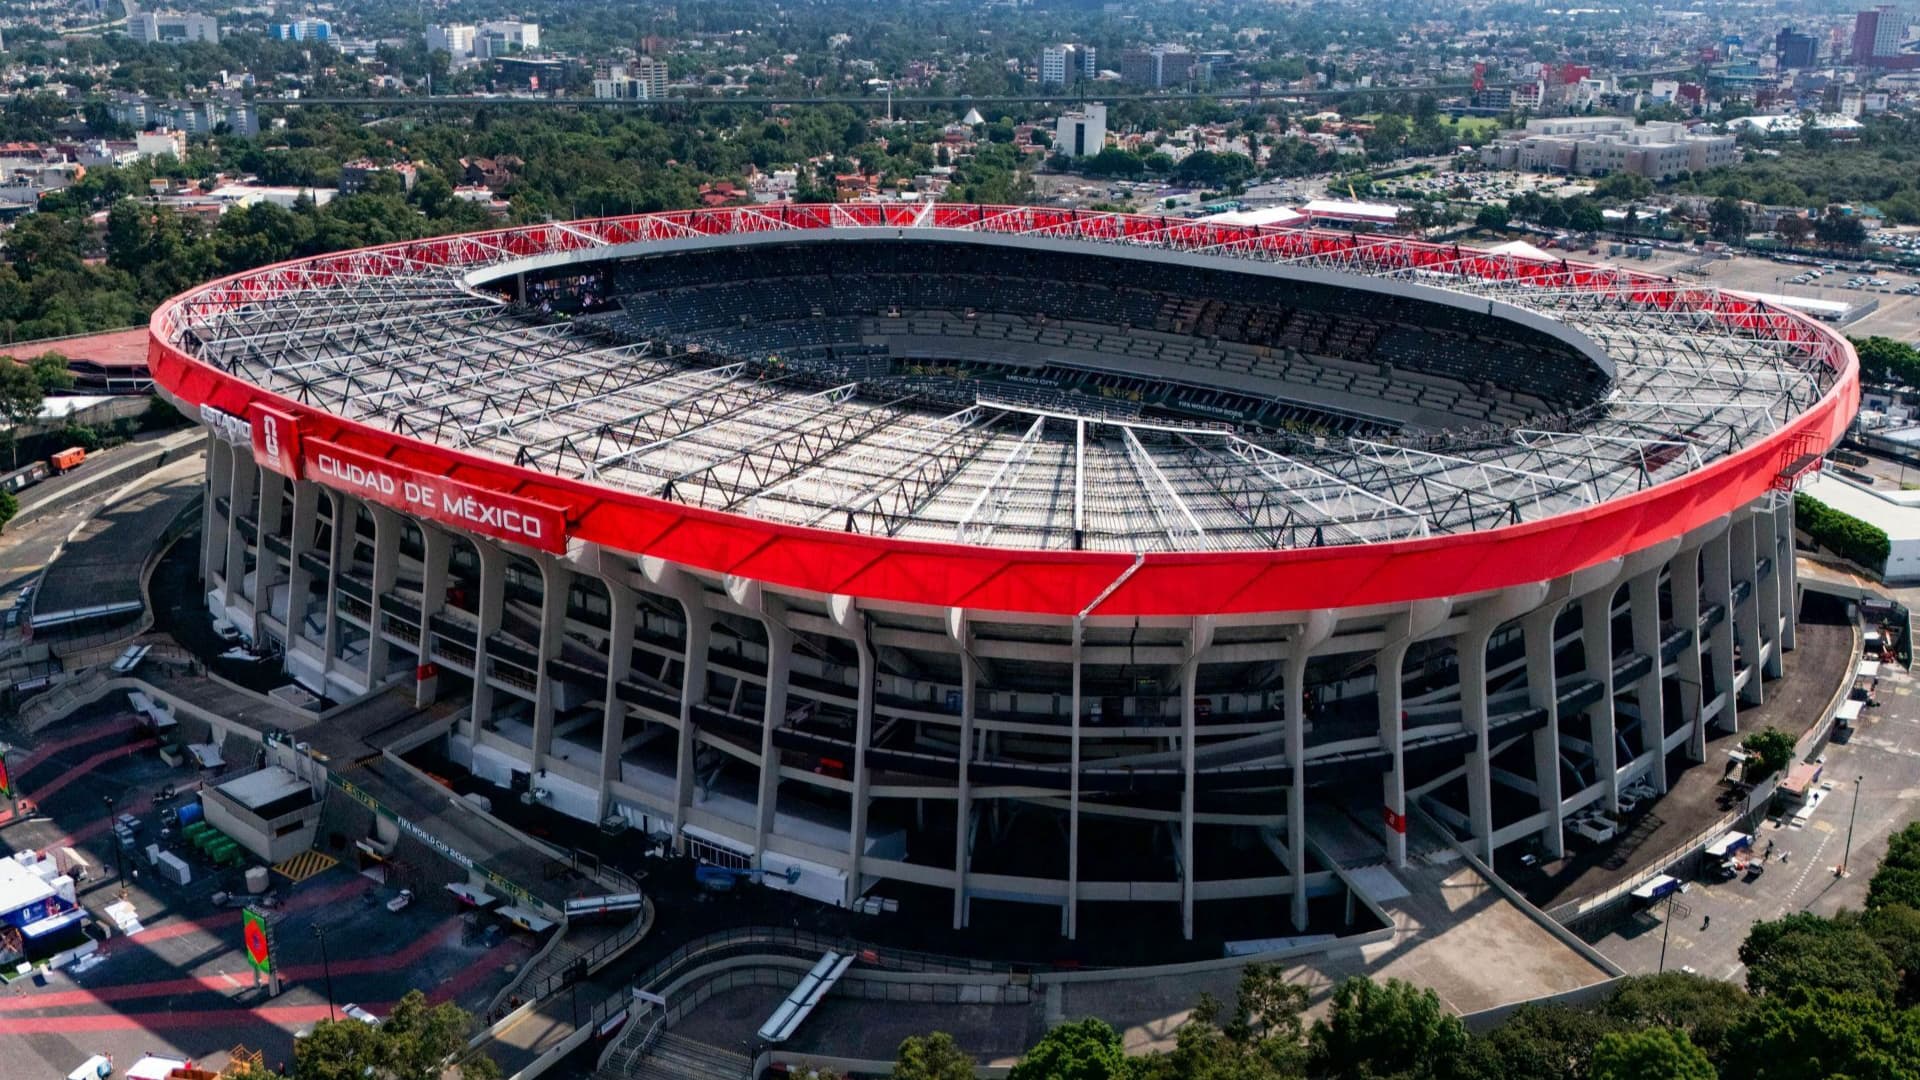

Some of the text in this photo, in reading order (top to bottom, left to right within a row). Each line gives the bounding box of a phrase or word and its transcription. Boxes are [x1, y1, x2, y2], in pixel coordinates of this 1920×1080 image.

[319, 454, 541, 538] CIUDAD DE MÉXICO
[397, 815, 473, 868] FIFA WORLD CUP 2026
